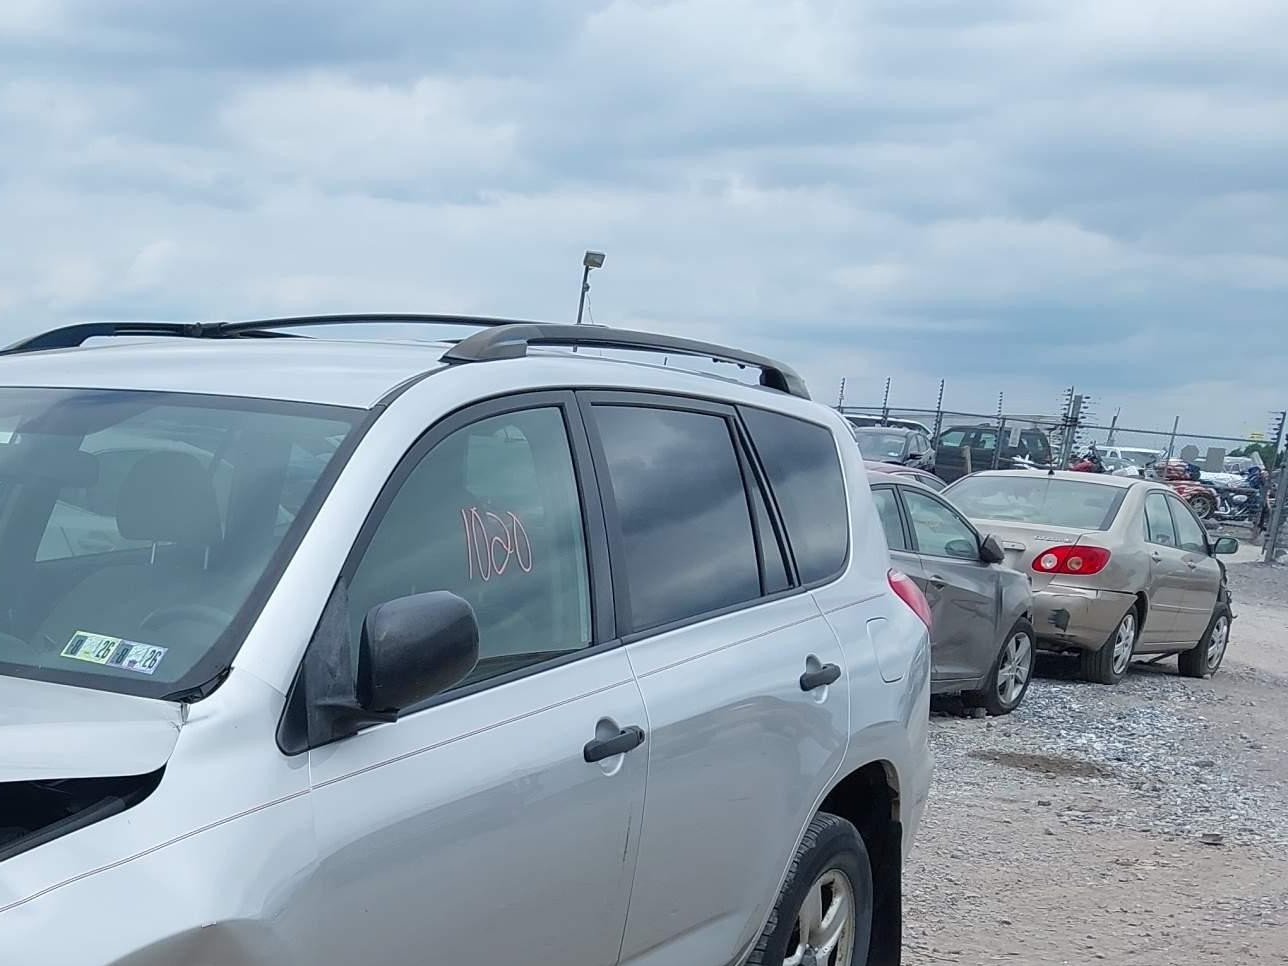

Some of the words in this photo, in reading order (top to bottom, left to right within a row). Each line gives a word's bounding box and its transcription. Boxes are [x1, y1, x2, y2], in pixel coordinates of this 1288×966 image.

[461, 507, 532, 581] 1020
[95, 640, 116, 659] 26
[142, 649, 162, 669] 26
